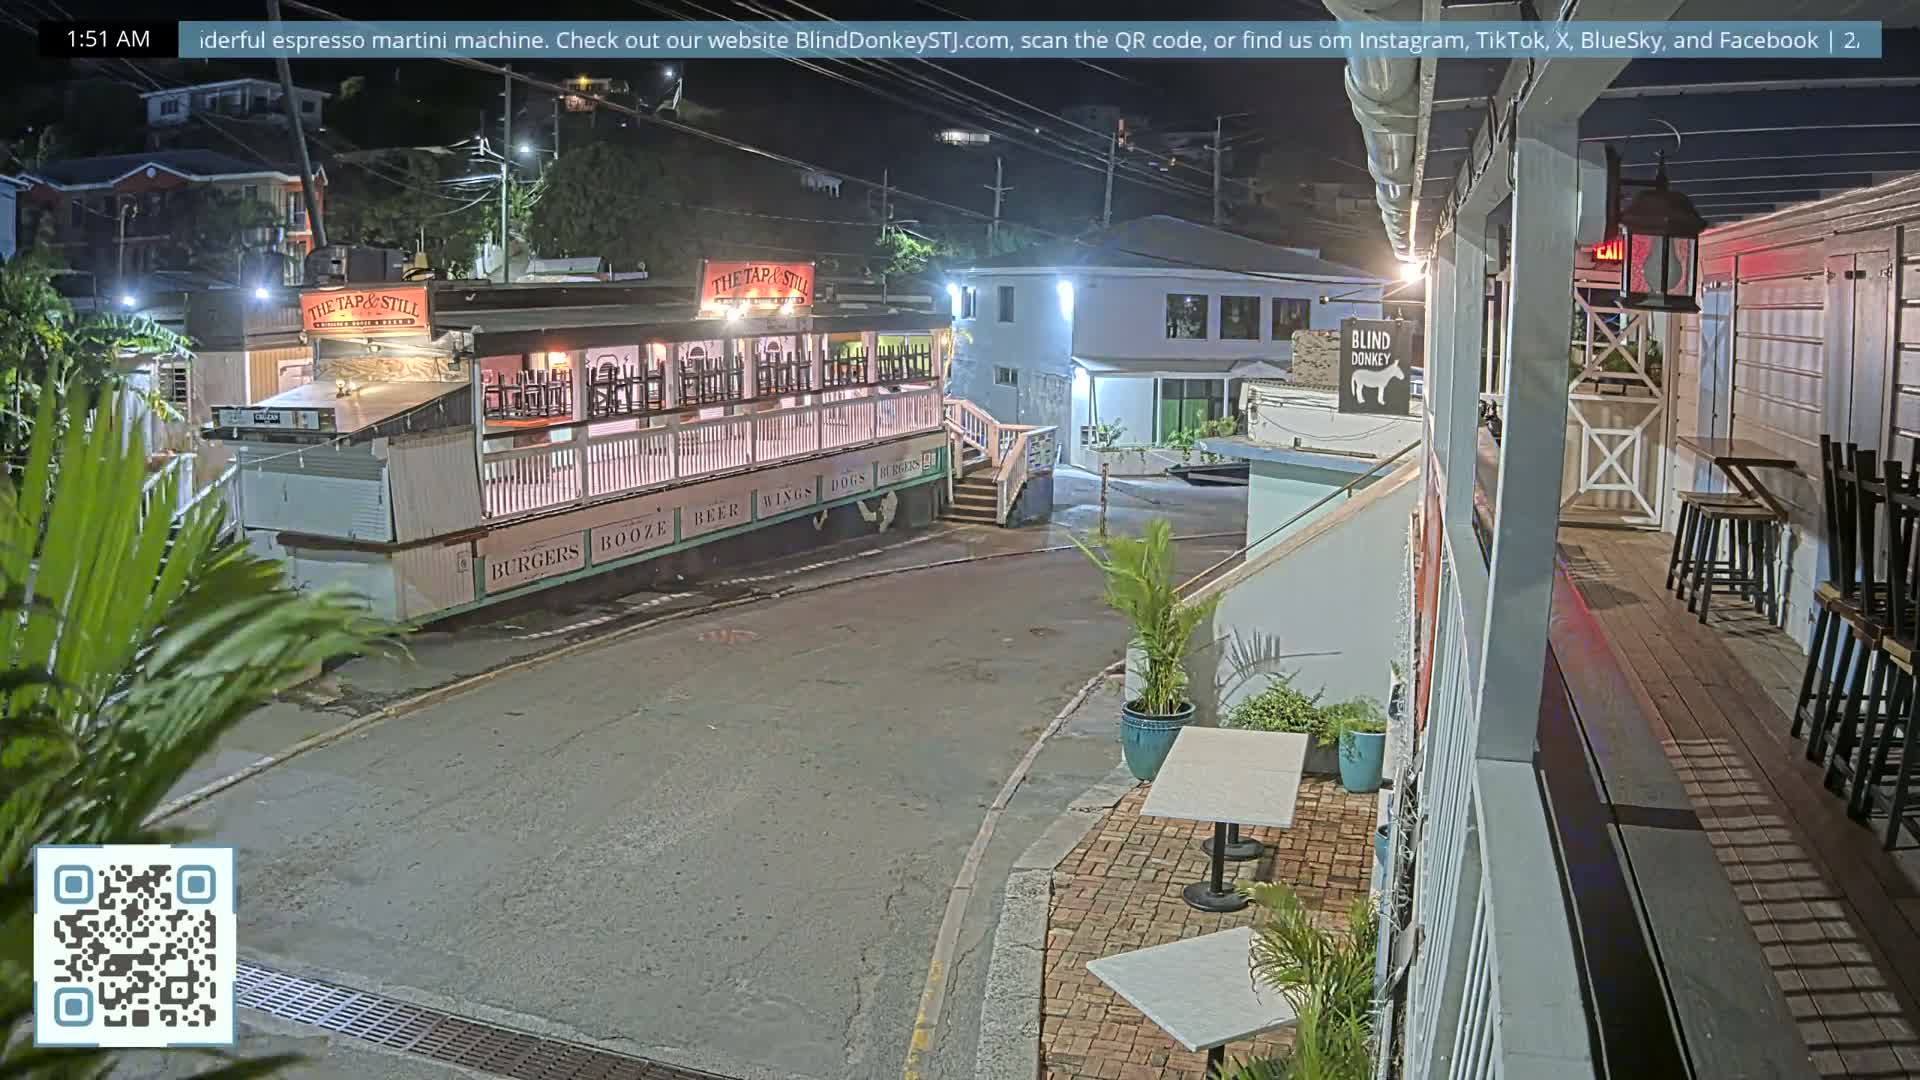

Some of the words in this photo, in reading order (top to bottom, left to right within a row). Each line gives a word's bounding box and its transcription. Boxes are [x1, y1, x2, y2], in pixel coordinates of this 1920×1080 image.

[711, 270, 743, 295] THE
[743, 267, 770, 284] TAP
[768, 266, 783, 284] &
[782, 270, 808, 296] STILL
[308, 299, 335, 321] THE
[335, 295, 364, 310] TAP
[362, 292, 380, 309] &
[380, 295, 419, 317] STILL
[1351, 329, 1391, 350] BLIND
[1351, 352, 1391, 366] DONKEY
[880, 459, 921, 479] BURGERS
[831, 472, 865, 492] DOGS
[763, 488, 812, 509] WINGS
[695, 503, 738, 526] BEER
[601, 520, 667, 551] BOOZE
[491, 544, 580, 581] BURGERS
